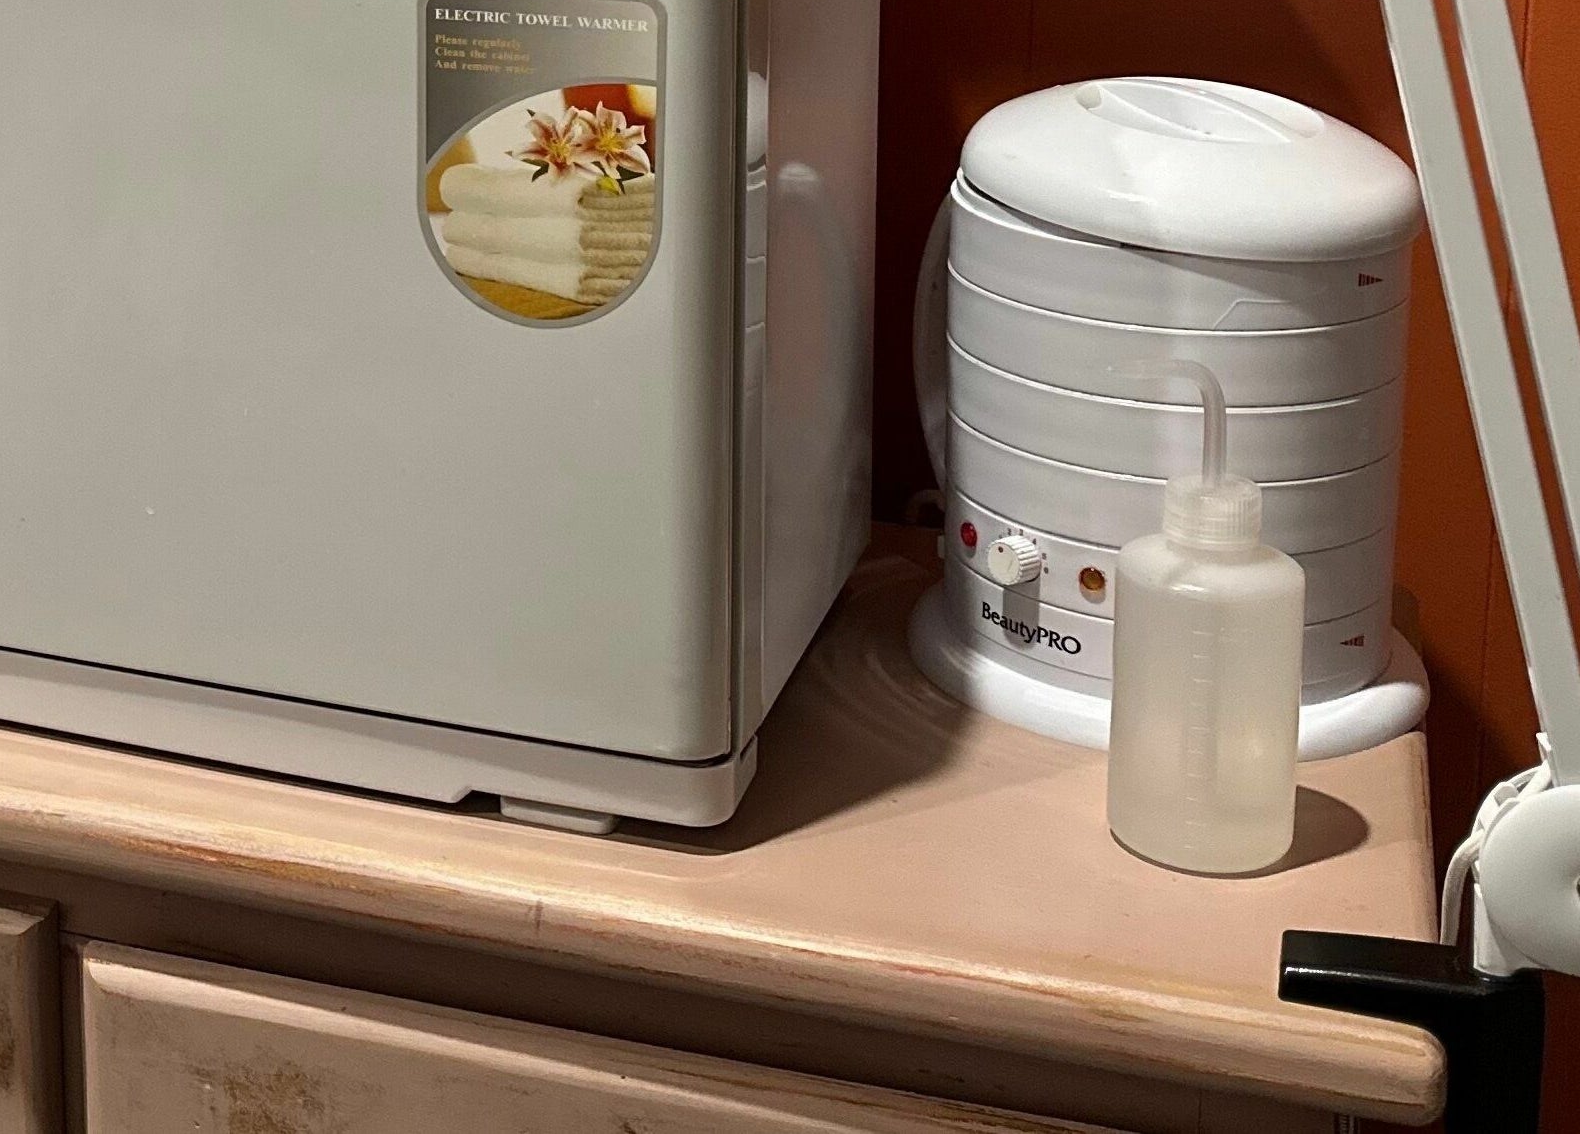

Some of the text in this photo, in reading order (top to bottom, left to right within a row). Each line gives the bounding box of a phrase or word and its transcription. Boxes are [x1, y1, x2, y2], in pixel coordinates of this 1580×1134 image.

[434, 8, 649, 33] ELECTRIC TOWEL WARMER
[434, 34, 468, 46] Please
[434, 47, 466, 58] Clean
[434, 59, 458, 71] And
[981, 601, 1082, 655] BeautyPRO
